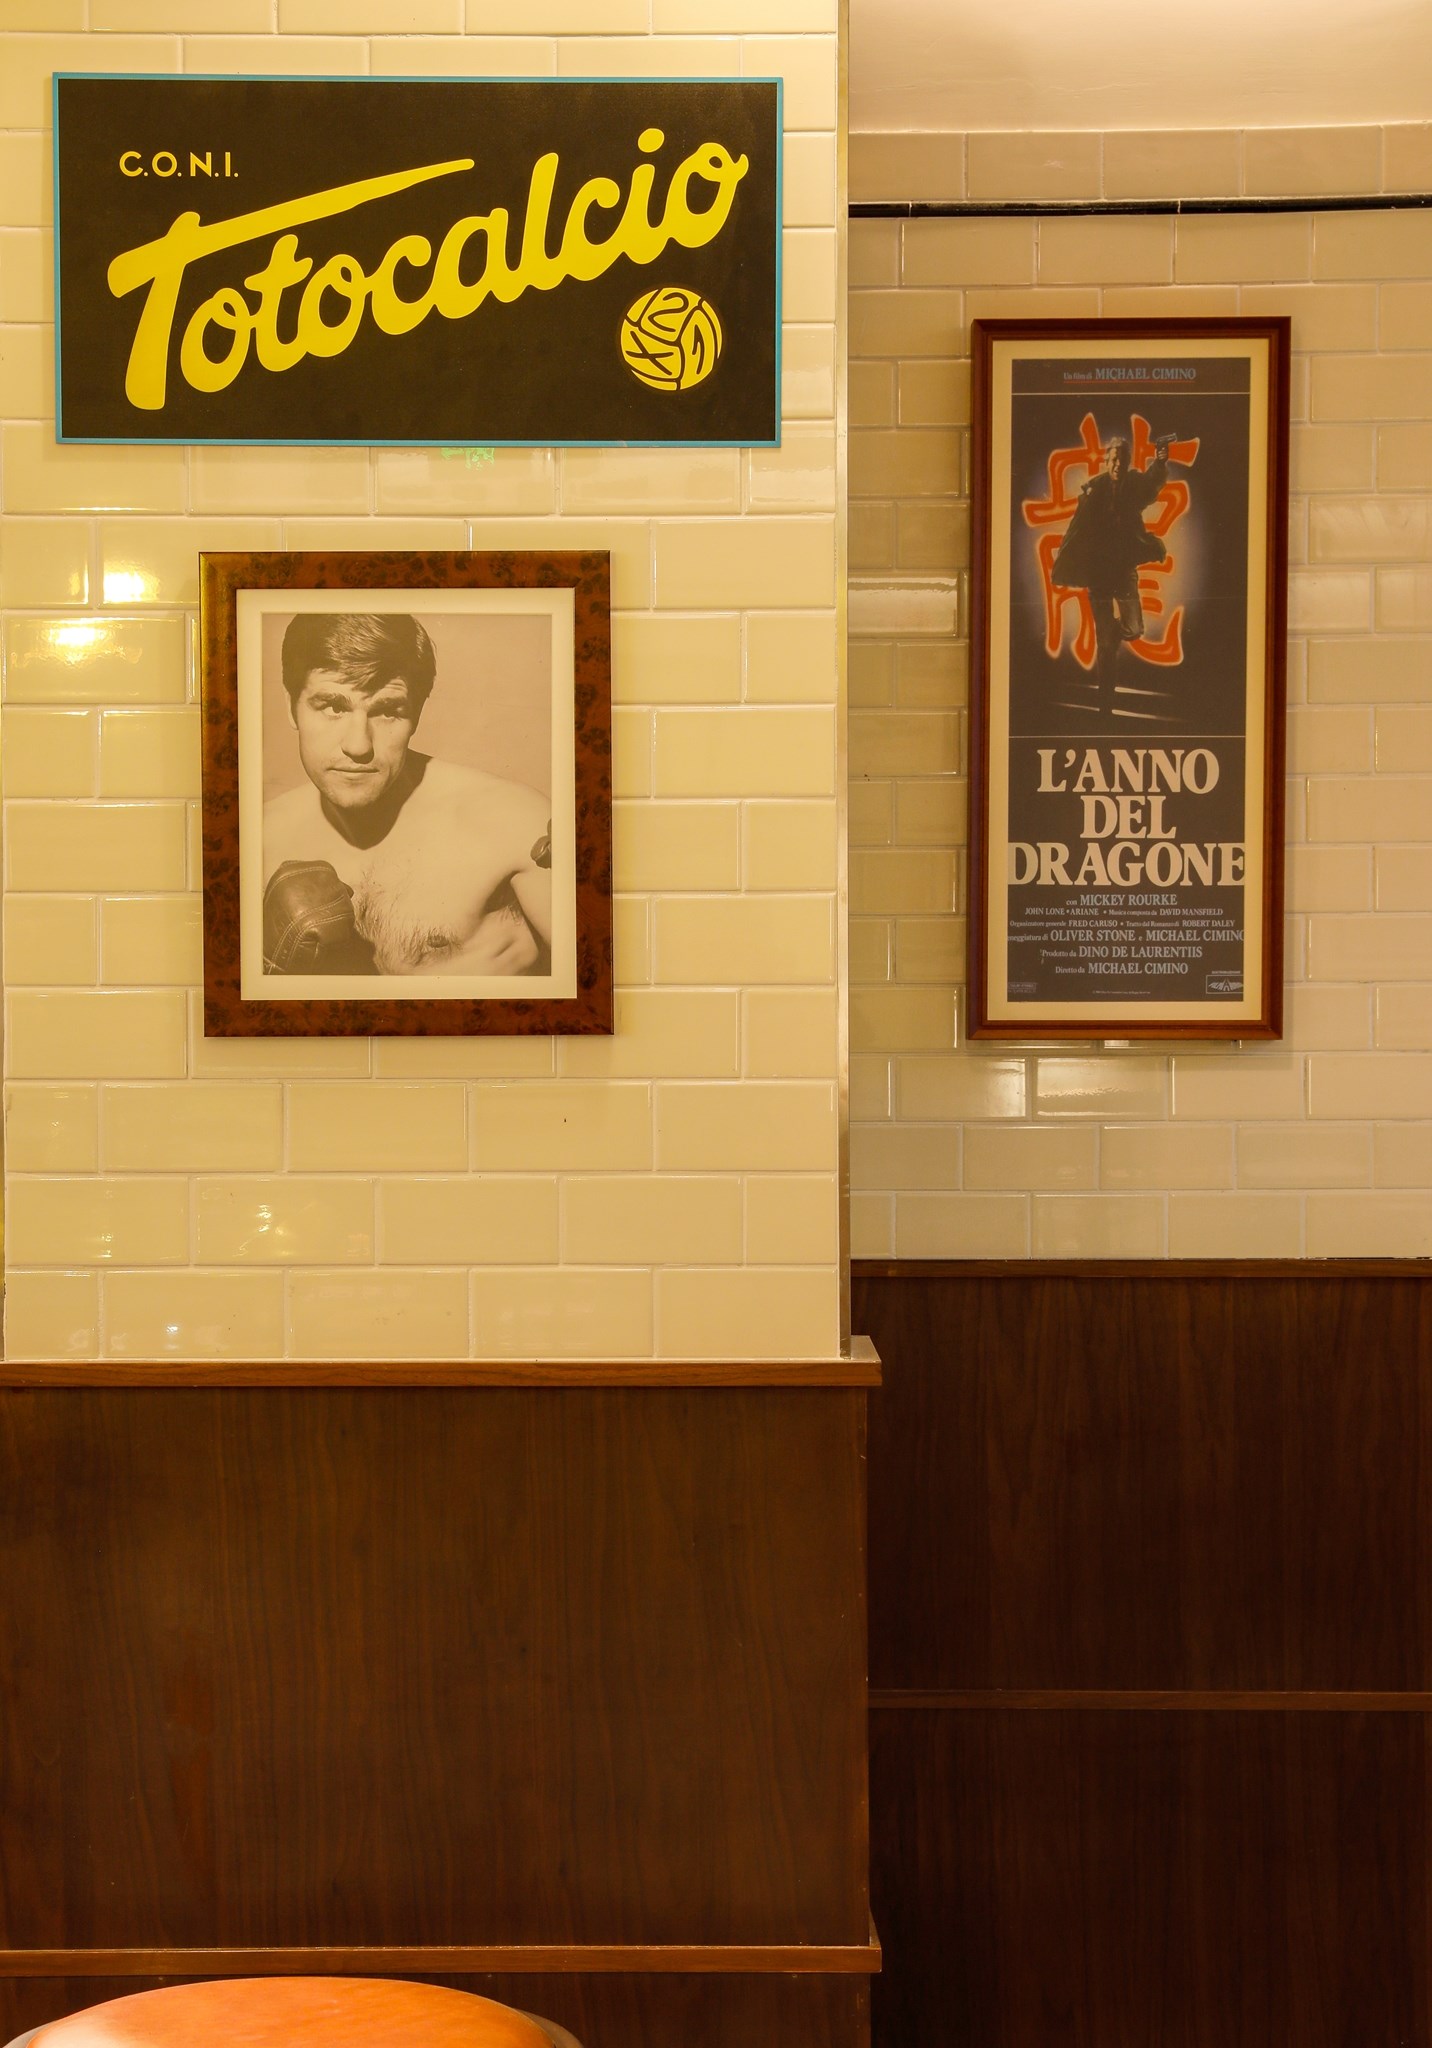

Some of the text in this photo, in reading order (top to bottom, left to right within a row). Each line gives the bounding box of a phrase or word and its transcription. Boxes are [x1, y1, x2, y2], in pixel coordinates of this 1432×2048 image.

[119, 151, 239, 178] C.O.N.I.
[107, 128, 749, 411] Totocalcio
[1064, 372, 1072, 380] Un
[1073, 372, 1085, 380] film
[1095, 368, 1150, 380] MICHAEL
[1152, 368, 1196, 380] CIMINO
[1037, 749, 1220, 794] L'ANNO
[1080, 795, 1176, 838] DEL
[1007, 841, 1245, 887] DRAGONE
[1080, 894, 1126, 906] MICKEY
[1128, 894, 1178, 906] ROURKE
[1024, 908, 1044, 916] JOHN
[1046, 908, 1065, 916] LONE
[1070, 908, 1099, 916] ARIANE
[1160, 908, 1181, 916] DAVID
[1182, 908, 1224, 916] MANSFIELD
[1050, 930, 1094, 942] OLIVER
[1096, 930, 1136, 942] STONE
[1146, 930, 1200, 942] MICHAEL
[1042, 949, 1068, 957] Prodotto
[1079, 946, 1108, 958] DINO
[1112, 946, 1128, 958] DE
[1131, 946, 1202, 958] LAURENTIIS
[1056, 962, 1188, 974] Diretto da MICHAEL CIMINO
